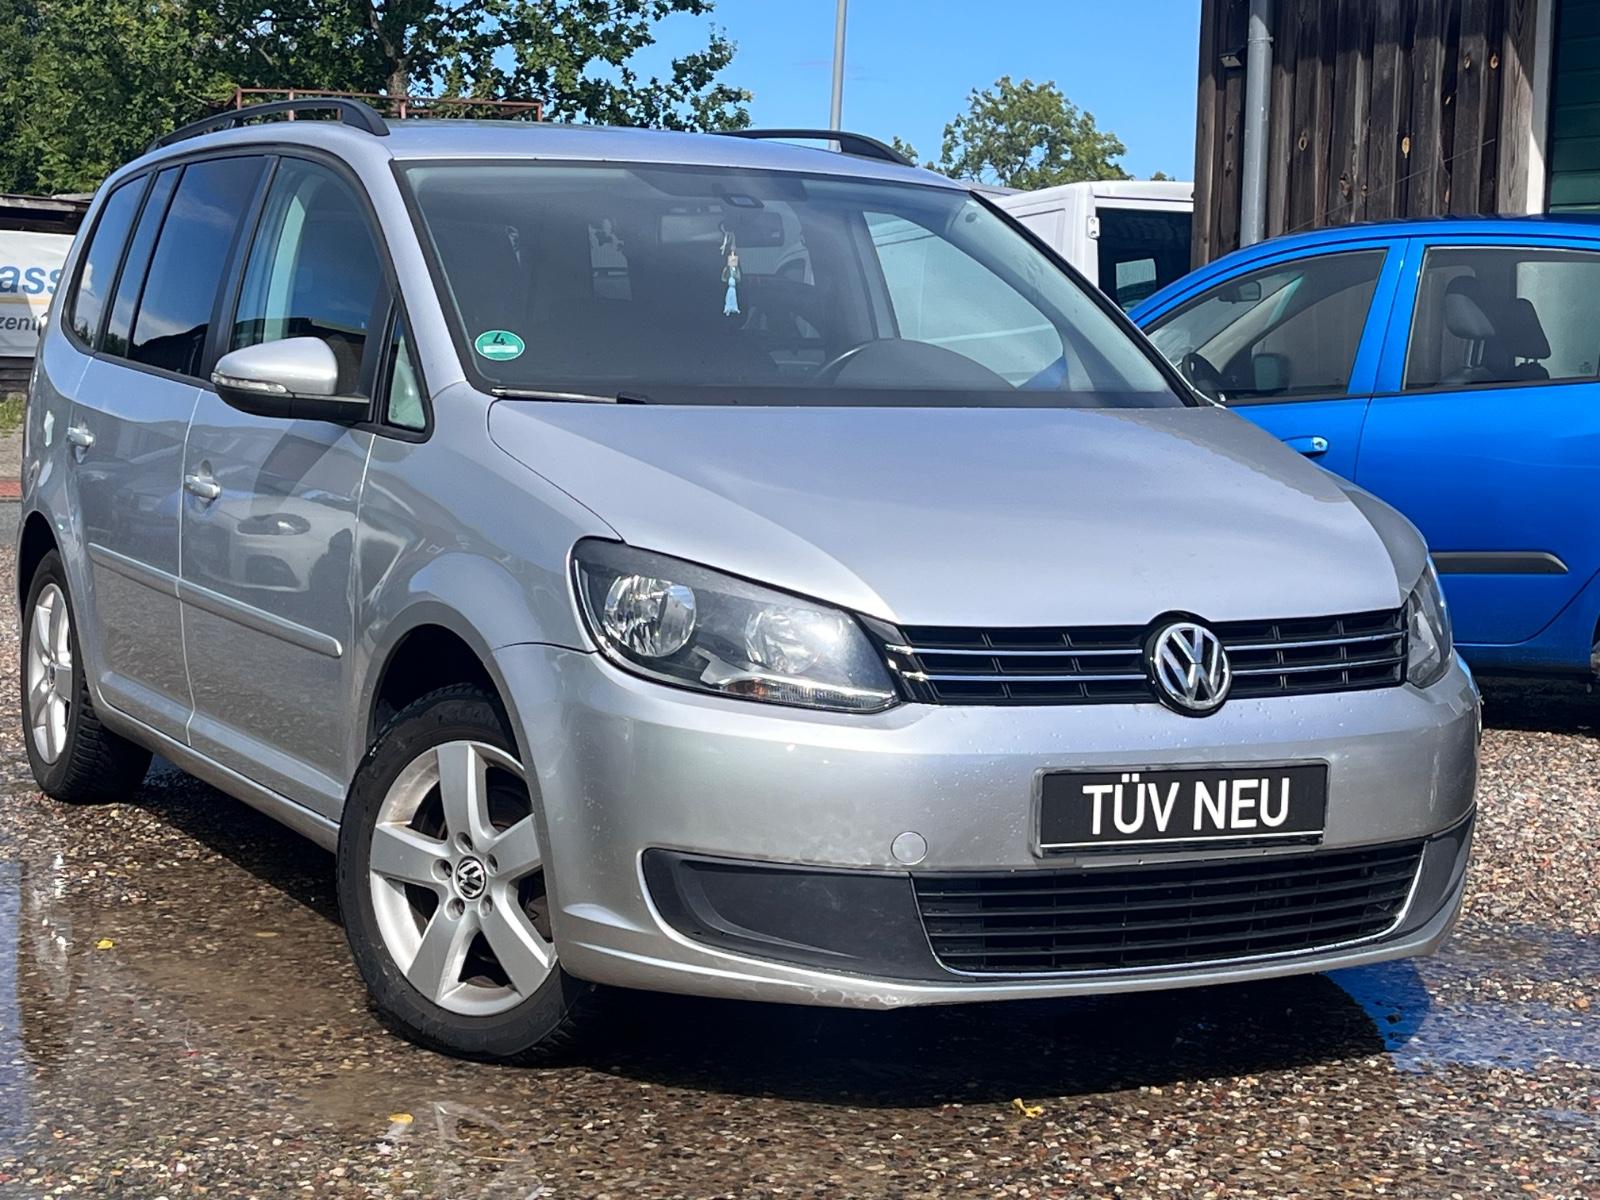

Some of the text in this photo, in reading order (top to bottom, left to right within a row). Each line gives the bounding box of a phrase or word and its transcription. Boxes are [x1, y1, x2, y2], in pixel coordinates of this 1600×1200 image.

[492, 332, 505, 346] 4
[1156, 624, 1227, 708] VW
[1082, 773, 1290, 835] TÜV NEU
